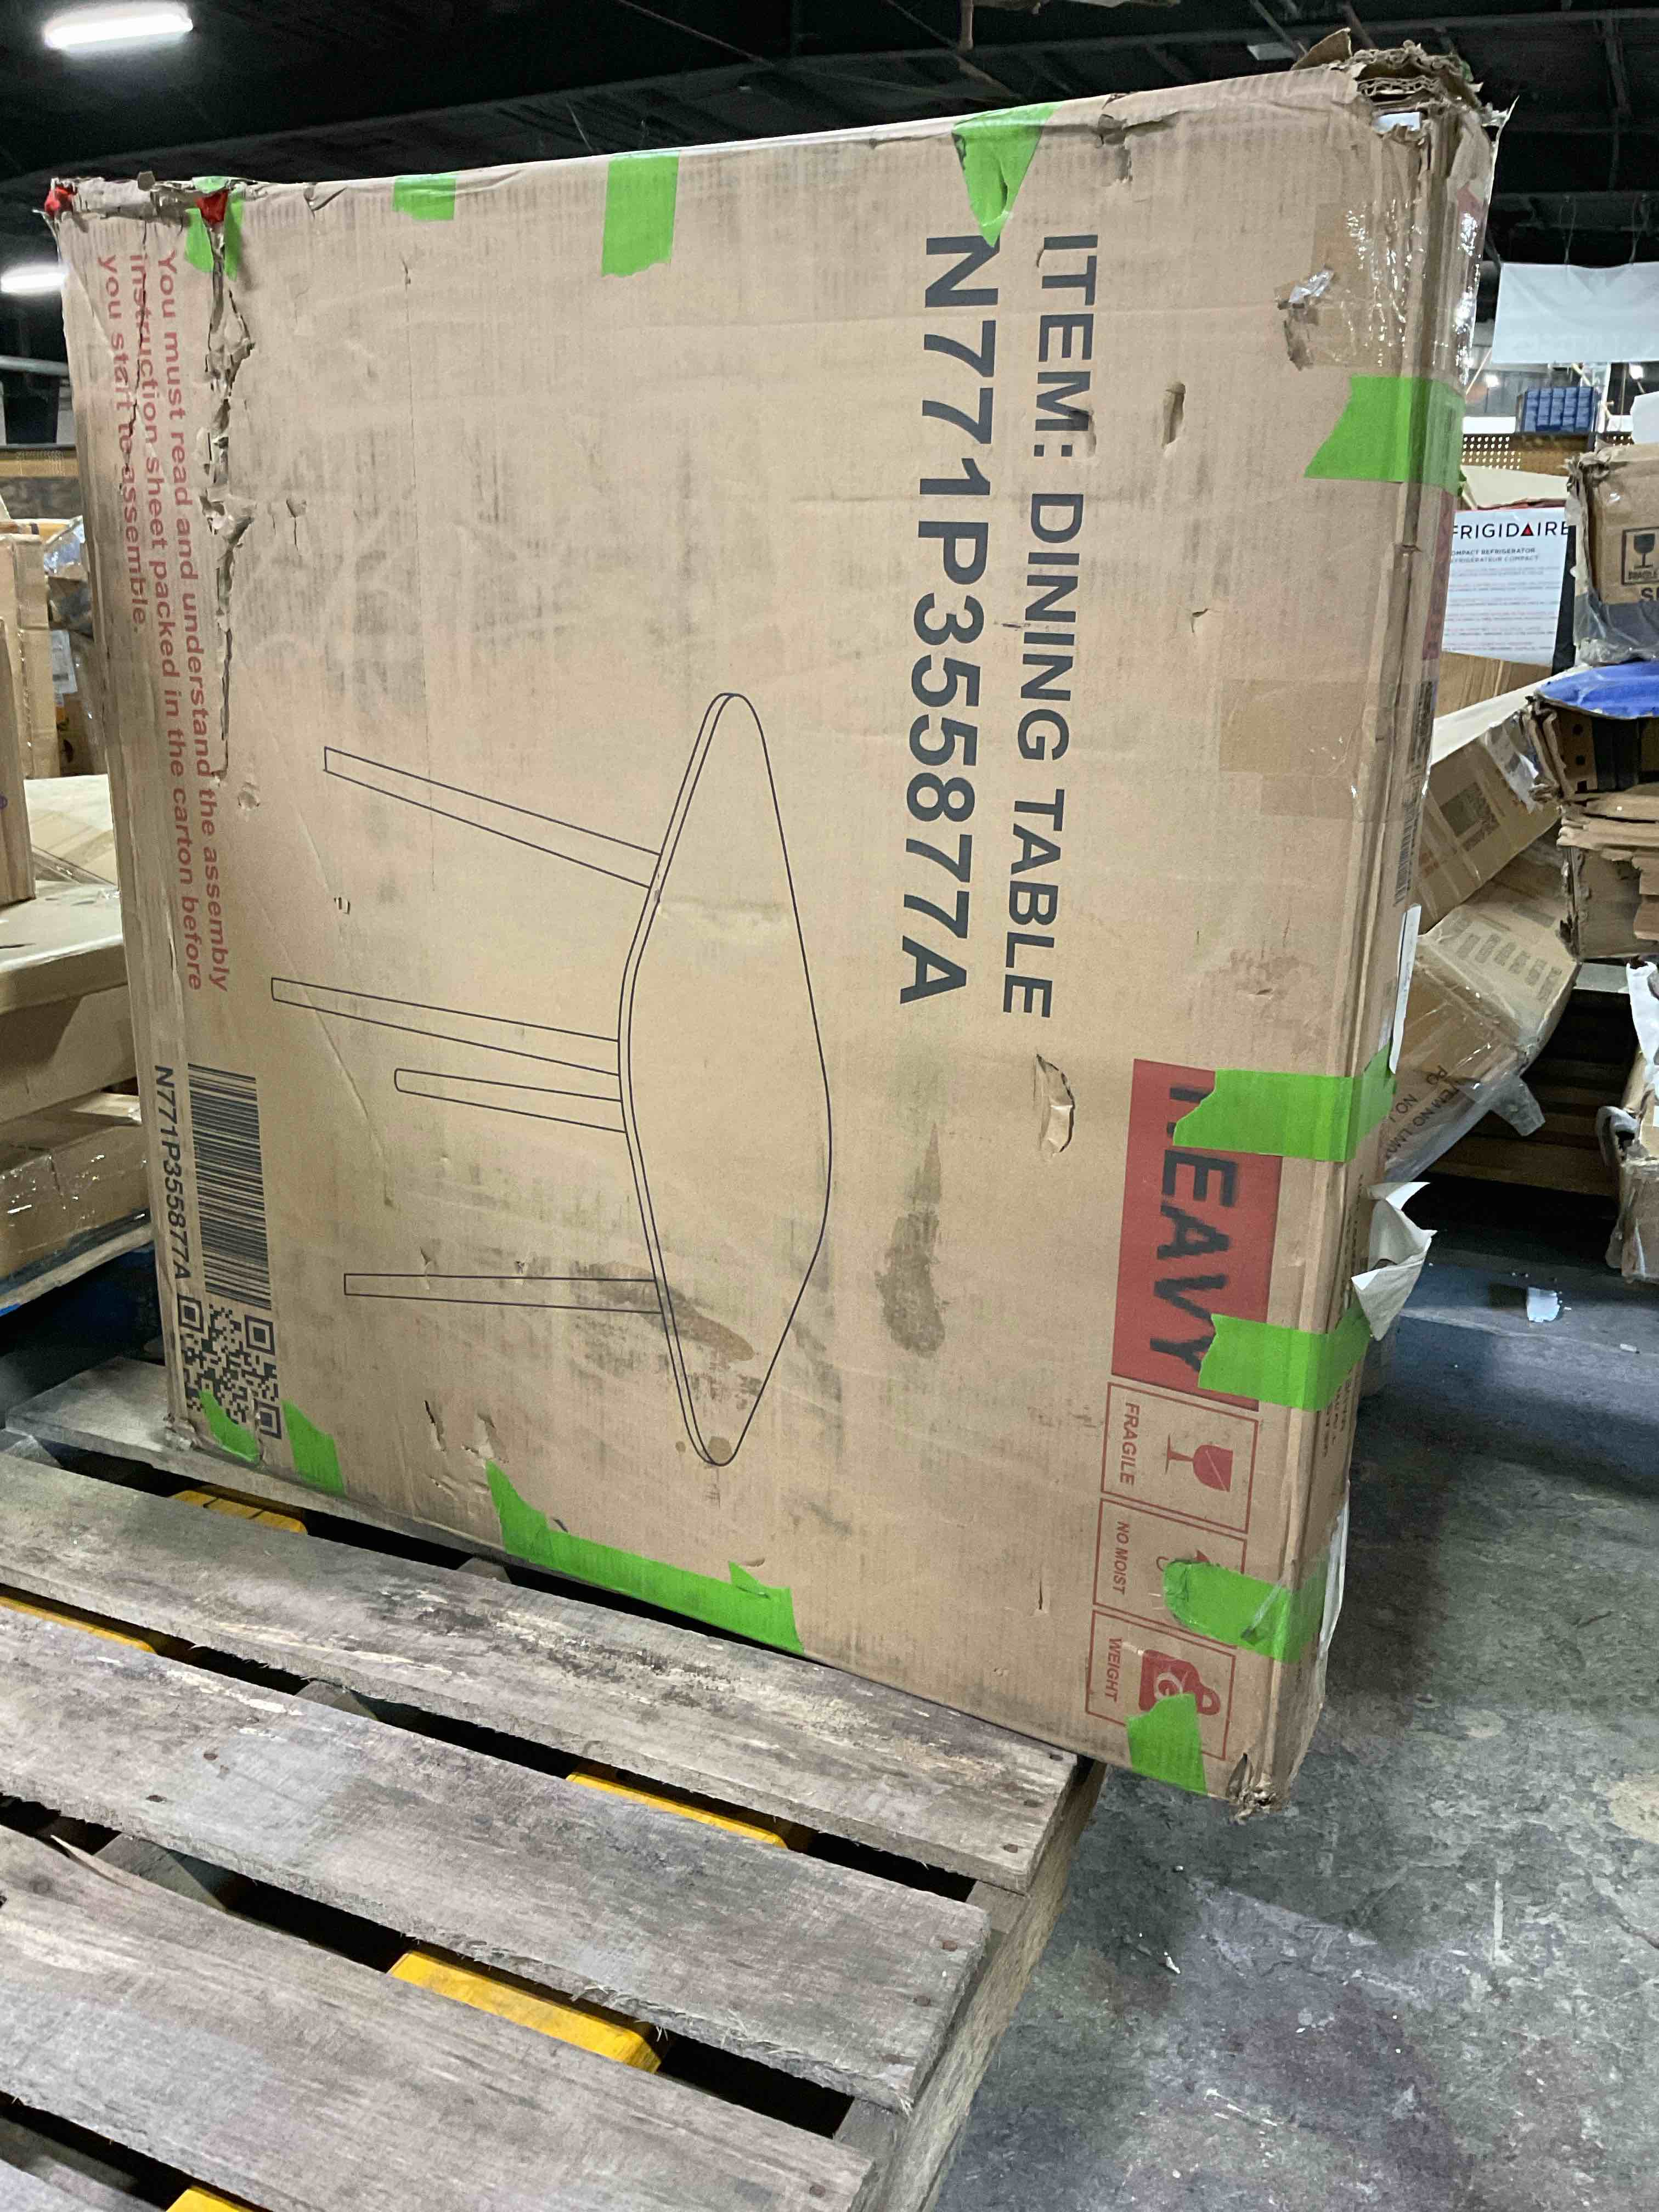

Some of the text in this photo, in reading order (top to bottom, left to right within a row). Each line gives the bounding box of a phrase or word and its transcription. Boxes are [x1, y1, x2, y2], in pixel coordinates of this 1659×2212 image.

[98, 254, 122, 319] you
[111, 332, 133, 410] start
[130, 253, 202, 990] instruction sheet packed in the carton before
[158, 250, 230, 992] You must read and understand the assembly
[900, 235, 1000, 1004] N771P355877A
[1003, 234, 1098, 1018] ITEM: DINING TABLE
[154, 1065, 191, 1279] N771P355877A
[1120, 1402, 1140, 1486] FRAGILE
[1111, 1521, 1131, 1595] NO MOIST
[1104, 1637, 1122, 1702] WEIGHT
